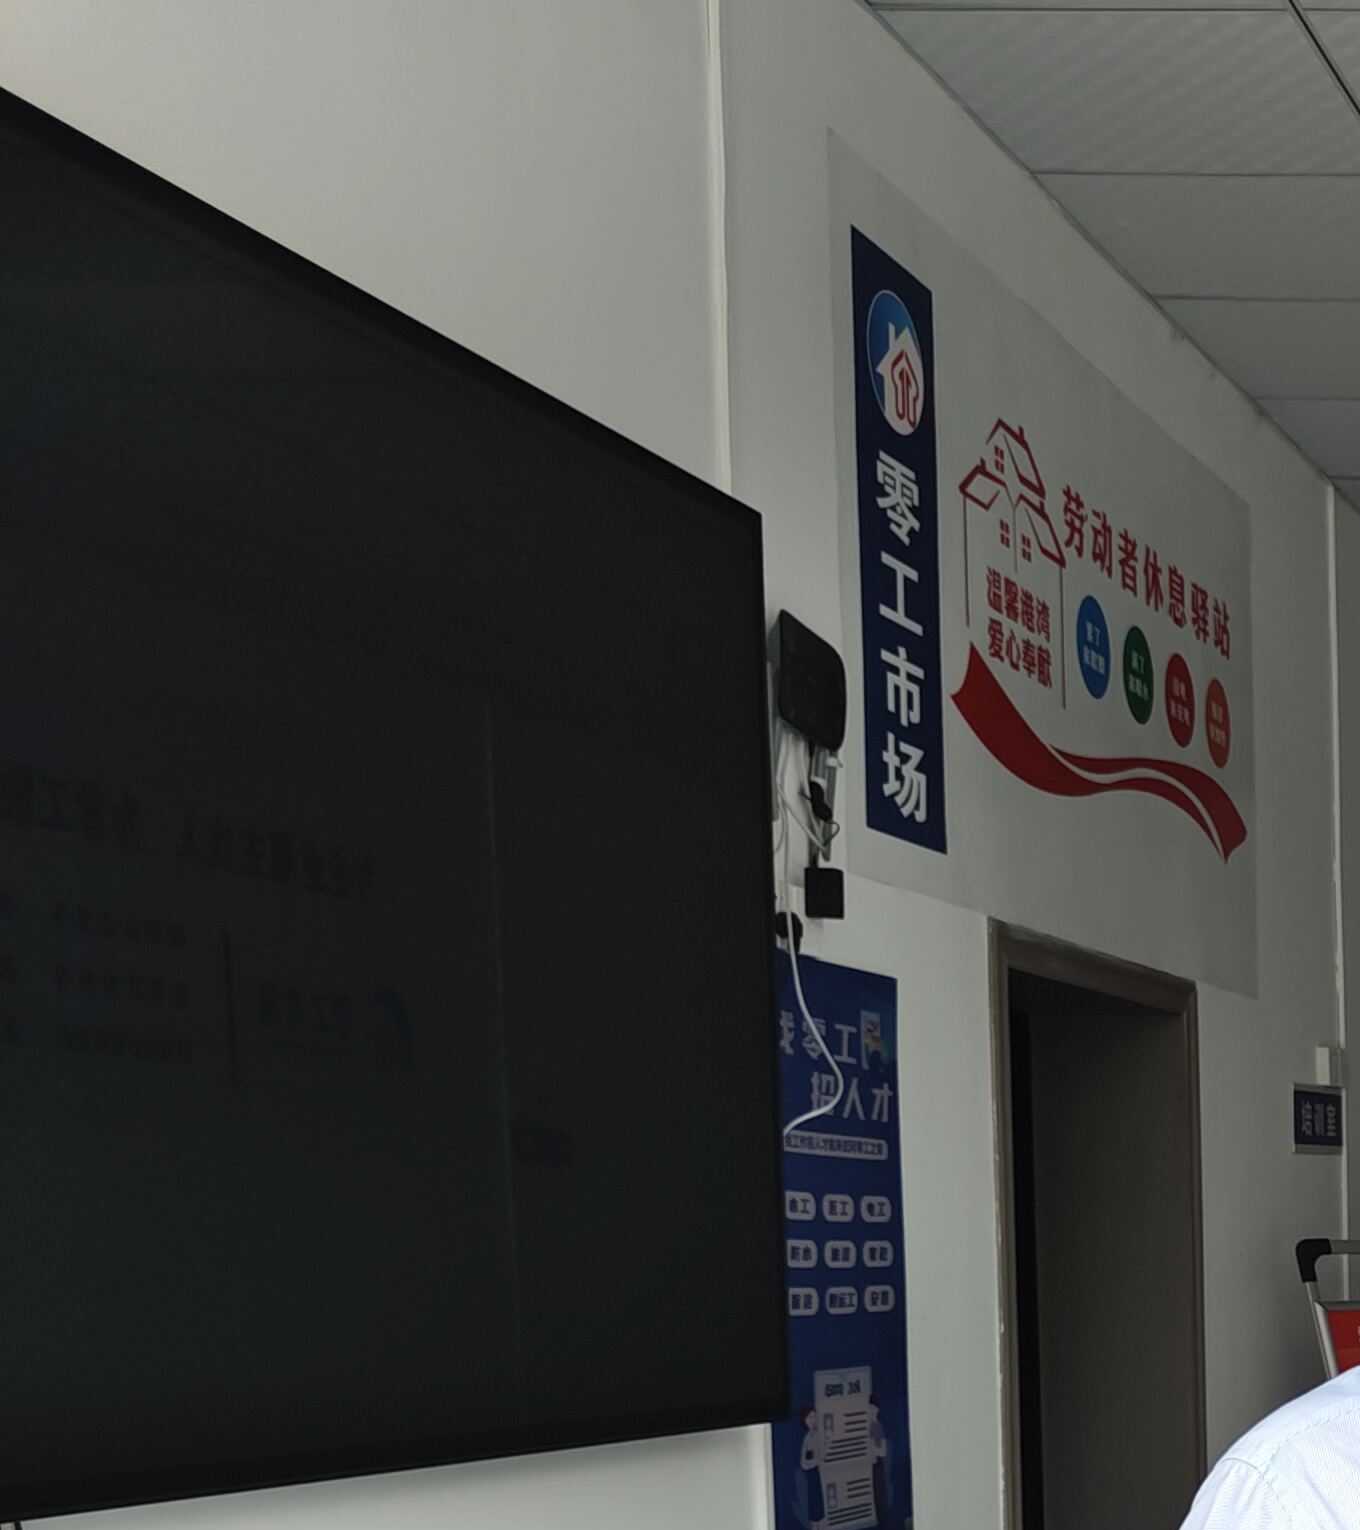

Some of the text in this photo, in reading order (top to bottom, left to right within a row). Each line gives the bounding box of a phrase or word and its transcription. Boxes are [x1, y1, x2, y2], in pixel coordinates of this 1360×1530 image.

[984, 566, 1052, 644] 温馨港湾
[1062, 484, 1231, 661] 劳动者休息驿站
[876, 450, 928, 824] 零工市场
[986, 618, 1053, 690] 爱心奉献
